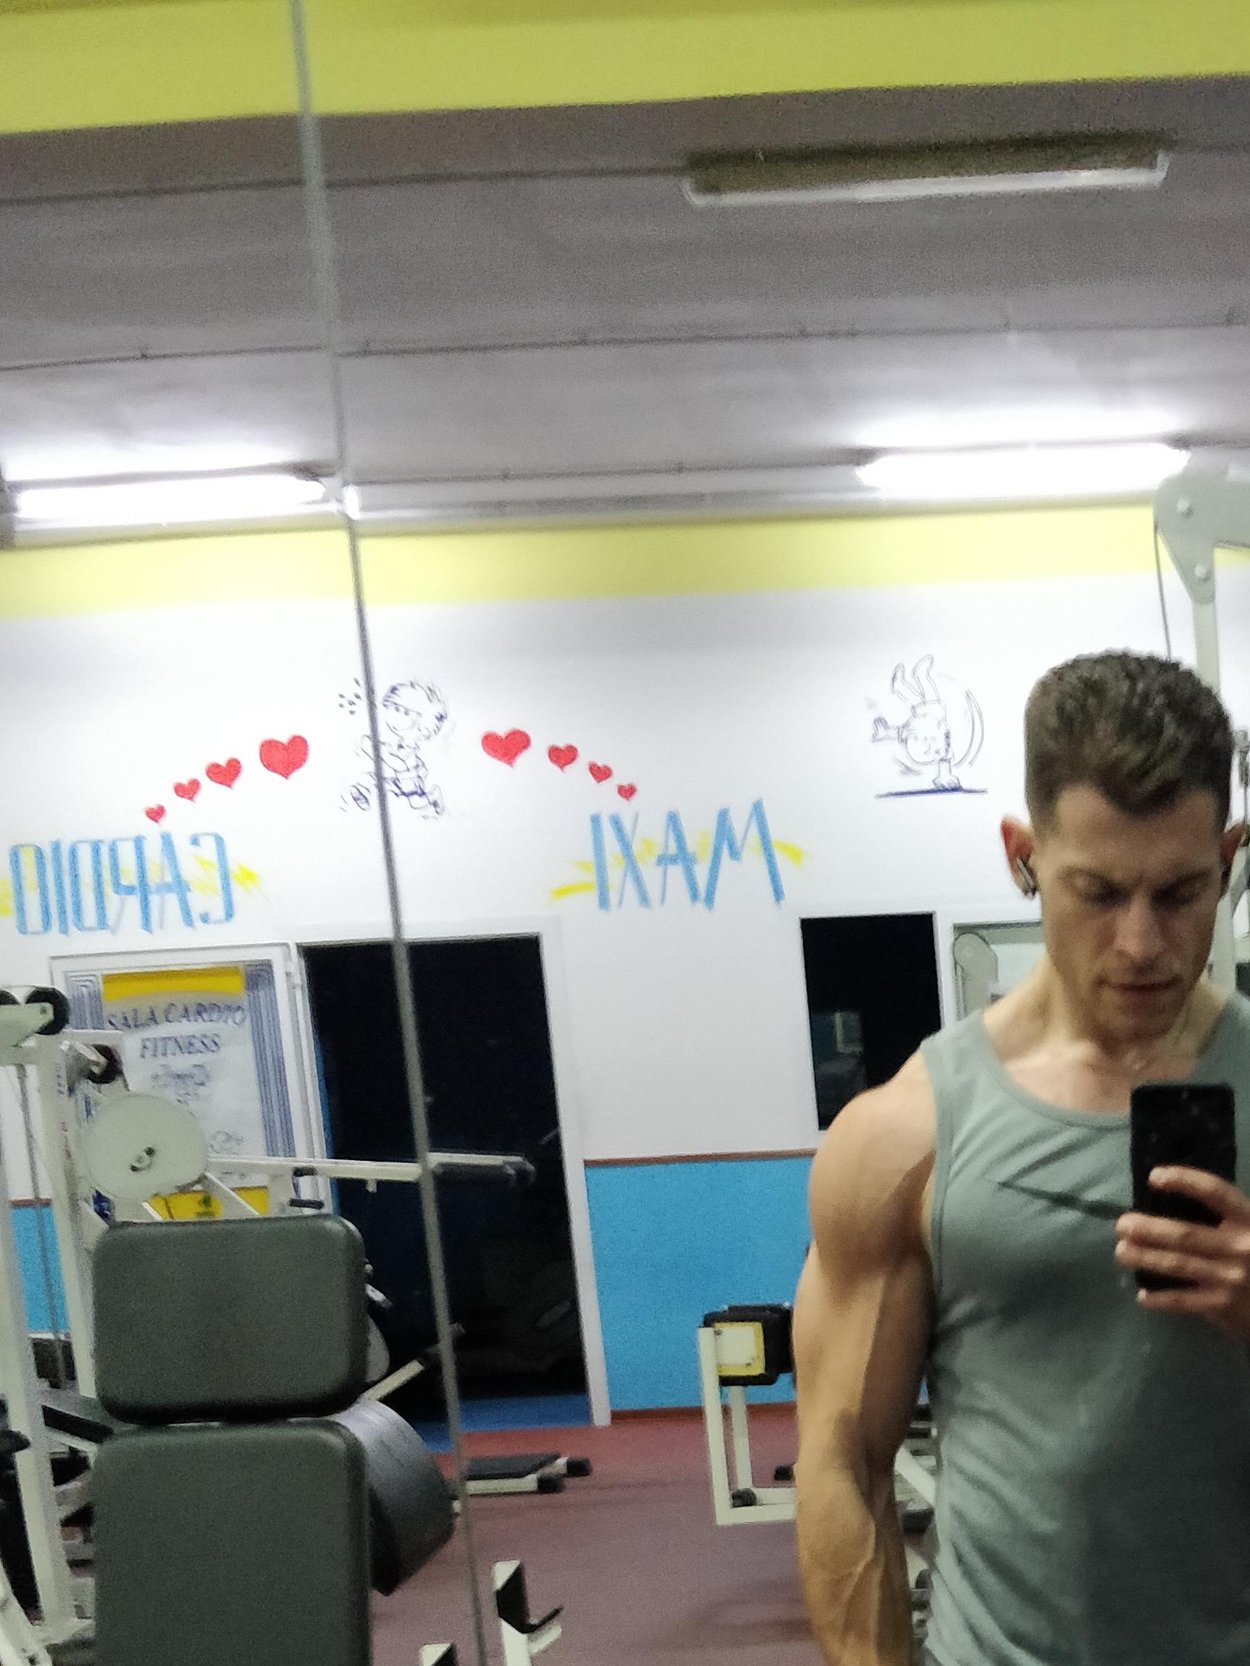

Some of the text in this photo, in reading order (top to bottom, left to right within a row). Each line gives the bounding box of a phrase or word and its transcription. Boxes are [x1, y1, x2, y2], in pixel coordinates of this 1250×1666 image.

[108, 1002, 246, 1031] SALA CARDIO
[139, 1033, 222, 1058] FITNESS
